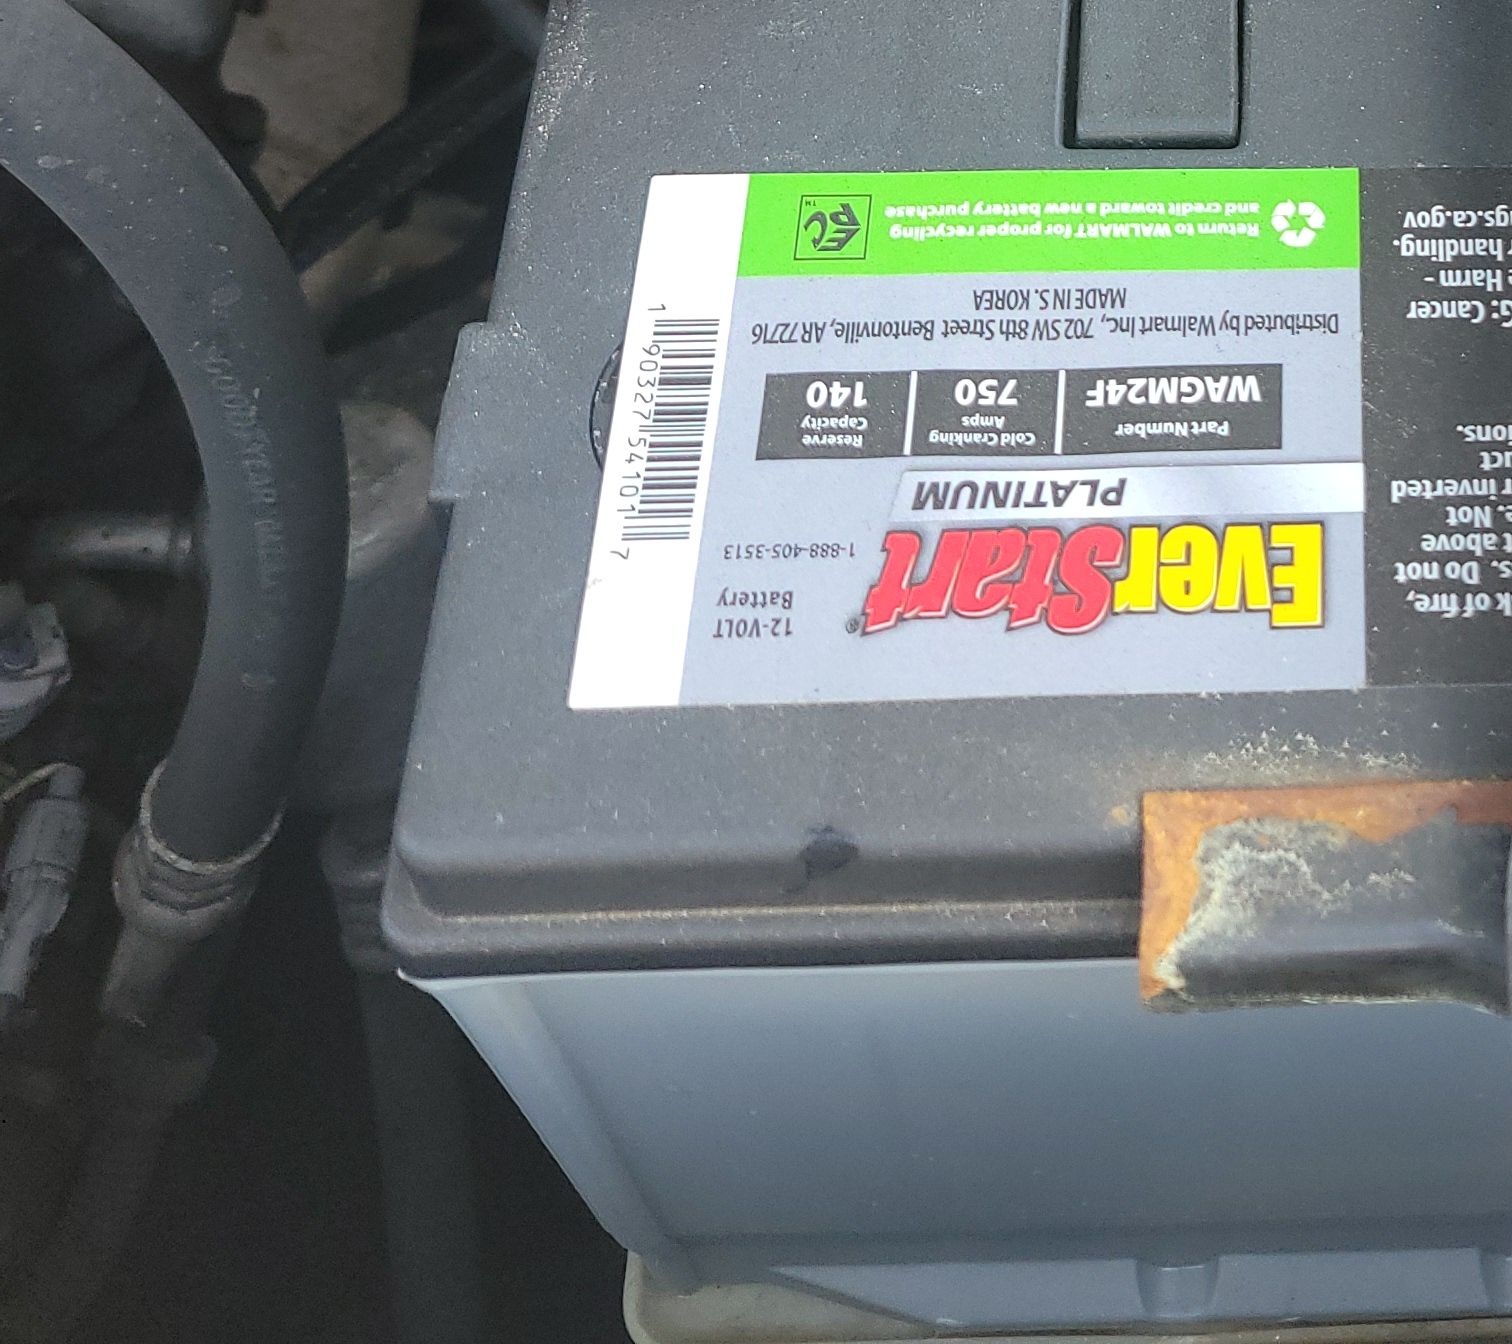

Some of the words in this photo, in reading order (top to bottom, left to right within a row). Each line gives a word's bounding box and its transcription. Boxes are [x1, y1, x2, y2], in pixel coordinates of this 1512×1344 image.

[885, 201, 970, 220] purchase
[973, 200, 1041, 218] battery
[1044, 202, 1083, 215] new
[1085, 202, 1096, 214] a
[1099, 202, 1165, 217] toward
[1168, 202, 1222, 217] credit
[1225, 202, 1260, 216] and
[889, 223, 974, 241] recycling
[978, 221, 1042, 238] proper
[1045, 223, 1072, 239] for
[1074, 222, 1172, 238] WALMART
[1174, 222, 1195, 236] to
[1197, 222, 1260, 237] Return
[1392, 233, 1503, 262] handling.
[1439, 268, 1503, 291] Harm
[973, 289, 1030, 310] KOREA
[1034, 289, 1050, 310] S.
[1053, 289, 1071, 309] IN
[1075, 288, 1126, 309] MADE
[1406, 300, 1485, 323] Cancer
[751, 323, 799, 344] 72716
[801, 322, 826, 343] AR
[830, 318, 935, 343] Bentonville,
[941, 319, 996, 341] Street
[999, 319, 1029, 341] 8th
[1031, 319, 1061, 340] SW
[1065, 318, 1094, 339] 702
[1139, 315, 1216, 337] Walmart
[1219, 310, 1240, 336] by
[1245, 313, 1339, 336] Distributed
[633, 344, 661, 421] 90327
[954, 377, 1019, 406] 750
[1084, 373, 1262, 407] WAGM24F
[805, 380, 868, 407] 140
[799, 414, 868, 431] Capacity
[961, 413, 1006, 430] Amps
[1115, 421, 1188, 438] Number
[1189, 420, 1230, 436] Part
[801, 433, 864, 448] Reserve
[928, 429, 998, 446] Cranking
[1000, 431, 1036, 446] Cold
[617, 436, 646, 513] 54101
[911, 478, 1128, 511] PLATINUM
[1391, 478, 1498, 503] inverted
[1445, 505, 1492, 528] Not
[609, 547, 629, 560] 7
[723, 542, 855, 560] 1-888-405-3513
[1420, 533, 1498, 556] above
[861, 522, 1325, 636] EverStart
[1393, 561, 1439, 584] not
[1444, 561, 1480, 585] Do
[716, 588, 794, 609] Battery
[1405, 590, 1461, 618] fire,
[1461, 592, 1490, 618] of
[713, 618, 792, 638] 12-VOLT
